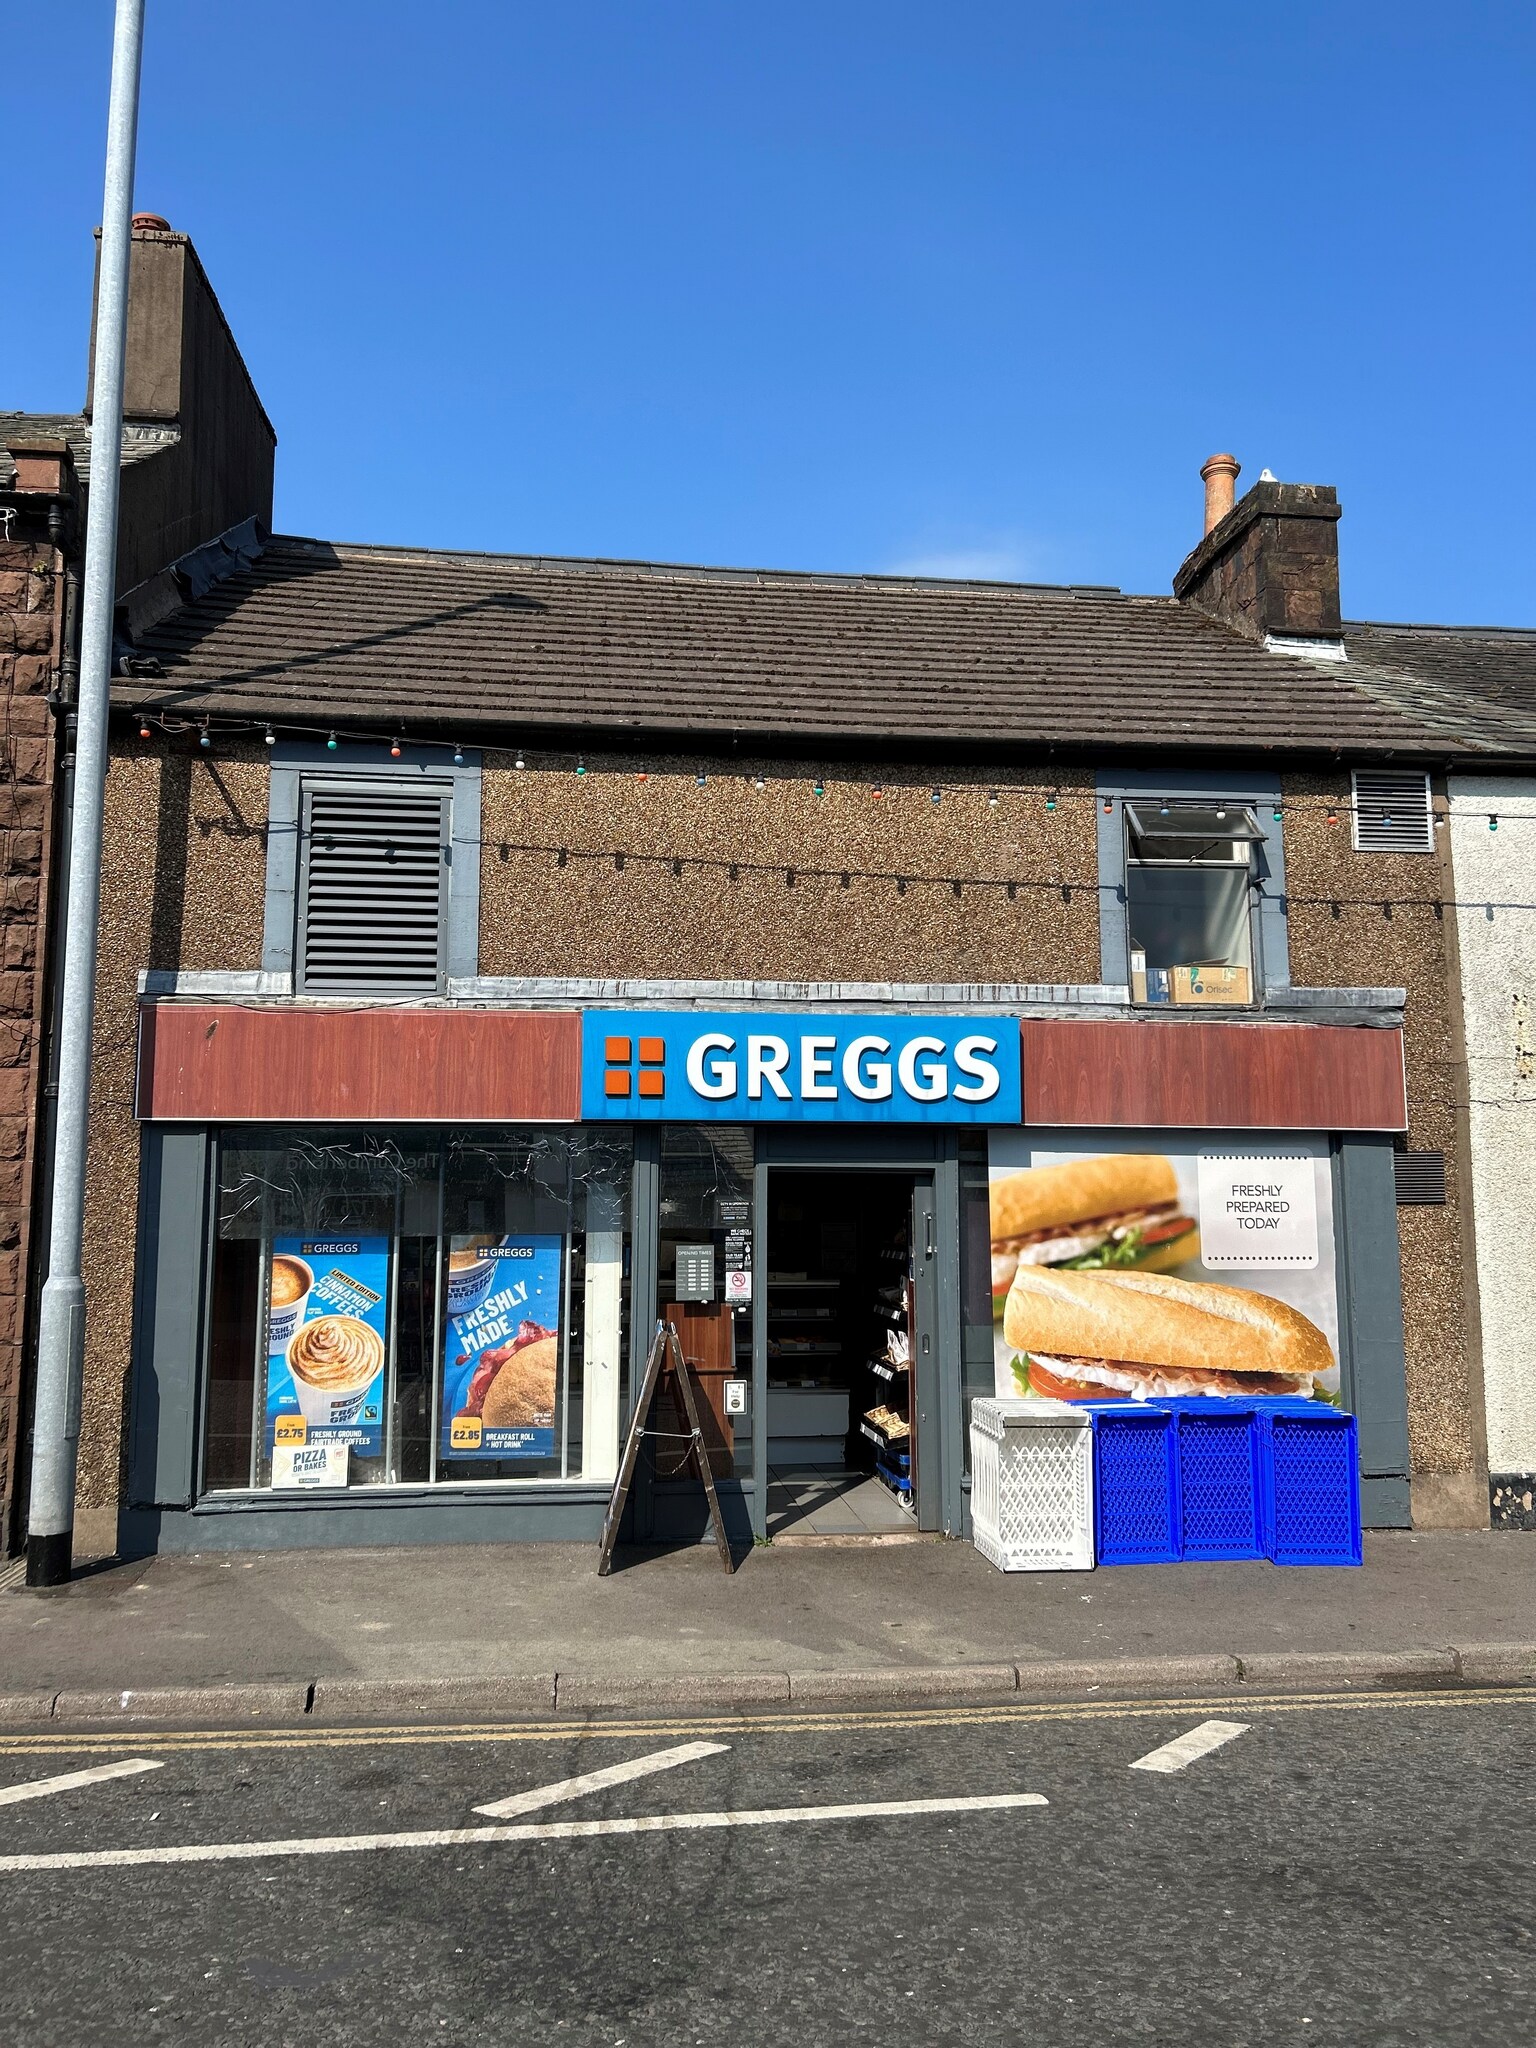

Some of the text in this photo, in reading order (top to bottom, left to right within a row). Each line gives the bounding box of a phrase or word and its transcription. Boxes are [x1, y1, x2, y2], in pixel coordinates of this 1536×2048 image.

[1206, 985, 1233, 993] Orisec
[686, 1033, 1001, 1101] GREGGS
[1231, 1184, 1283, 1197] FRESHLY
[1226, 1201, 1290, 1213] PREPARED
[1236, 1217, 1281, 1229] TODAY
[314, 1244, 358, 1253] GREGGS
[490, 1248, 533, 1257] GREGGS
[331, 1269, 380, 1302] LIMITED EDITION
[320, 1275, 375, 1312] CINNAMON
[311, 1282, 364, 1319] COFFEES
[451, 1280, 529, 1335] FRESHLY
[460, 1314, 513, 1355] MADE
[311, 1430, 362, 1438] FRESHLY GROUND
[453, 1430, 479, 1440] £2.85
[294, 1448, 327, 1464] PIZZA
[293, 1465, 302, 1473] OR
[304, 1461, 327, 1471] BAKES
